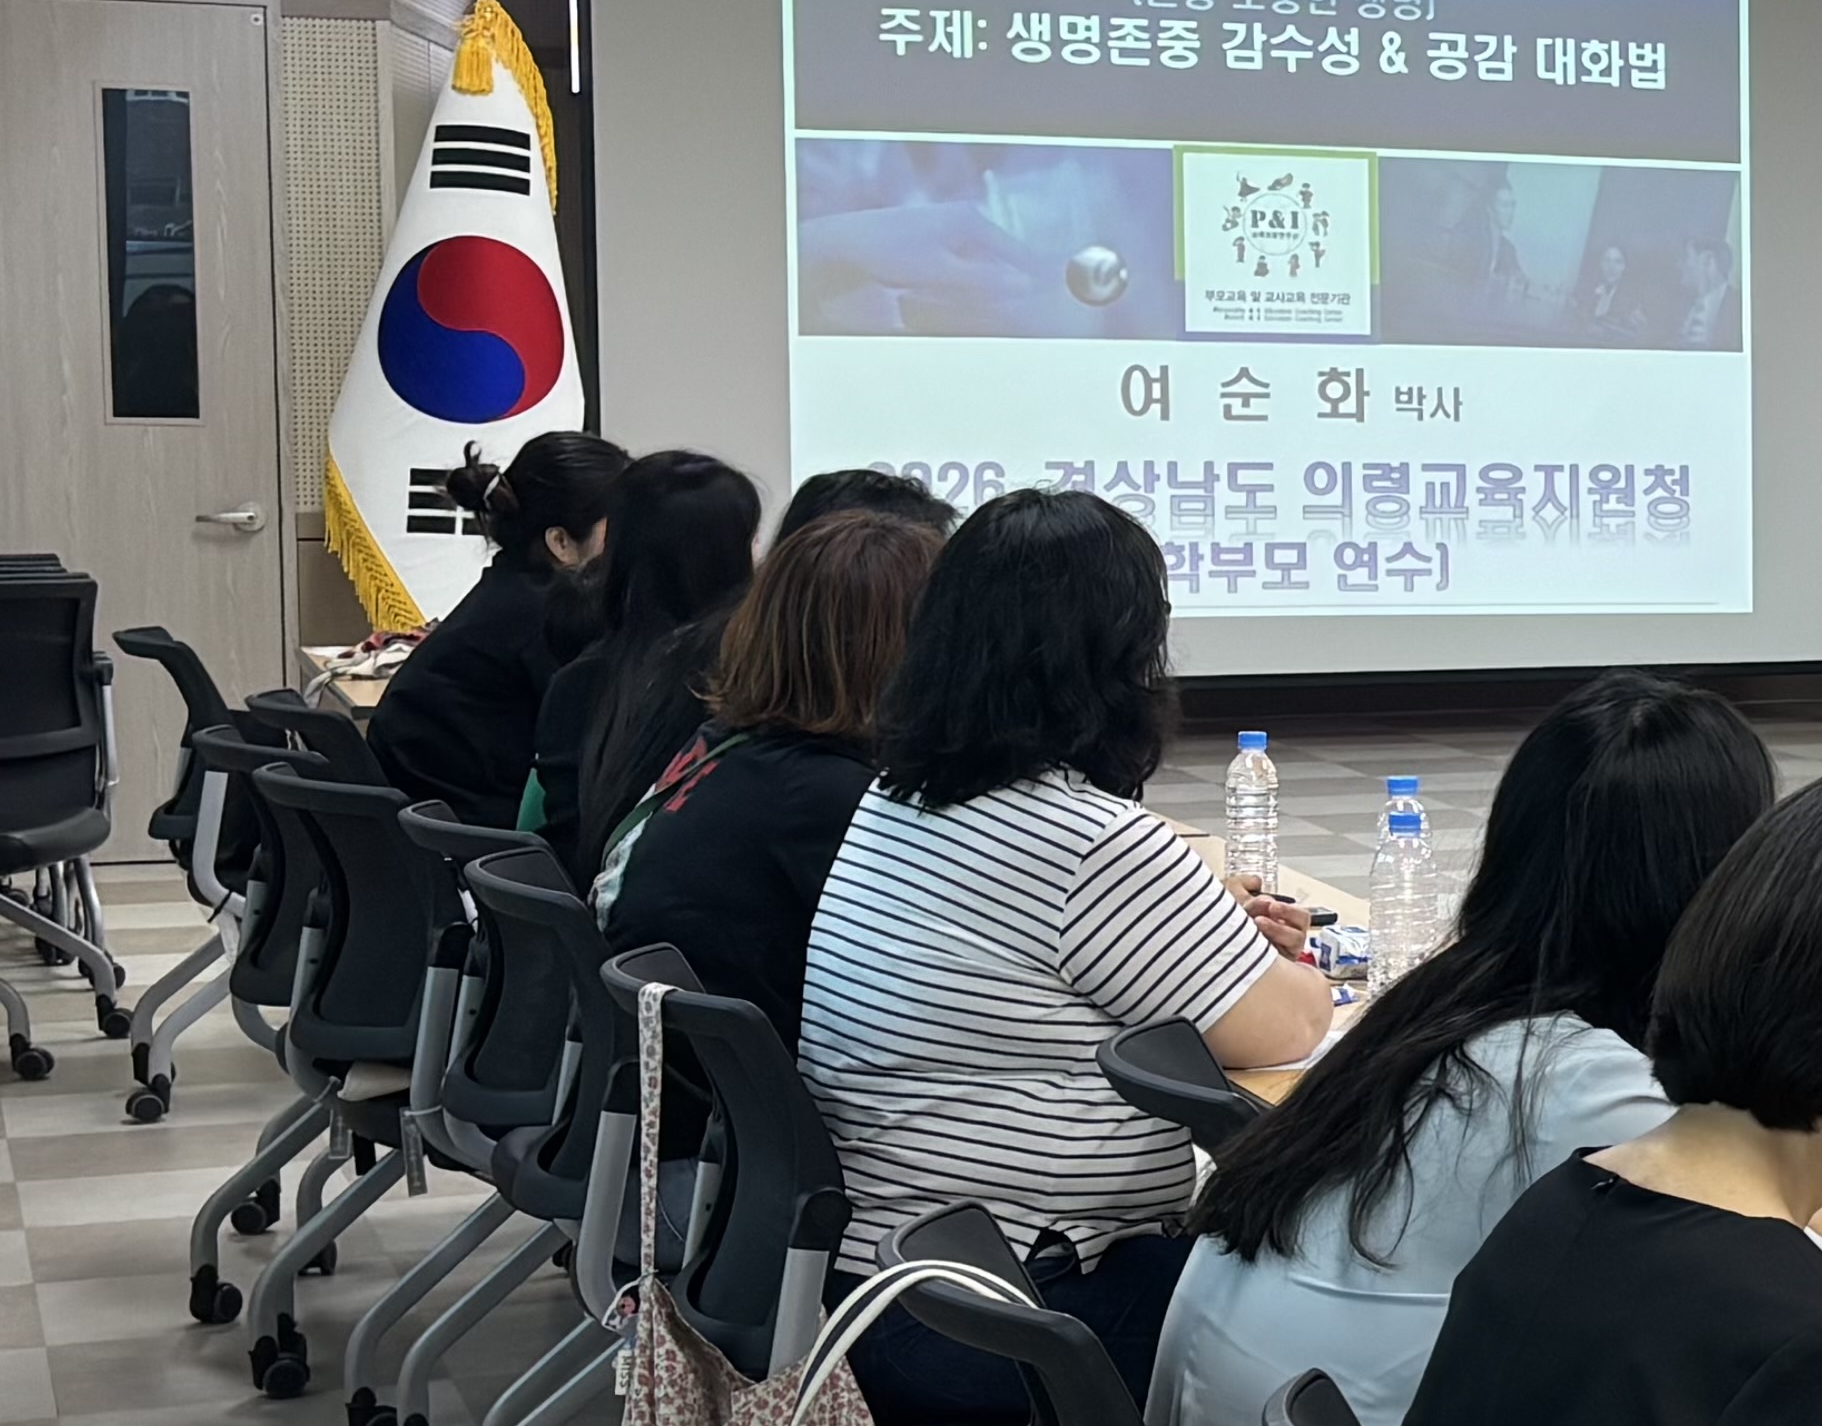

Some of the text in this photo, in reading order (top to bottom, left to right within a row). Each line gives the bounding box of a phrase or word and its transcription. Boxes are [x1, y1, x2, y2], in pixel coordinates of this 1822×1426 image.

[878, 7, 1667, 90] 주제: 생명존중 감수성 & 공감 대화법
[1120, 363, 1463, 423] 여 순 화 박사
[1302, 460, 1691, 520] 의령교육지원청
